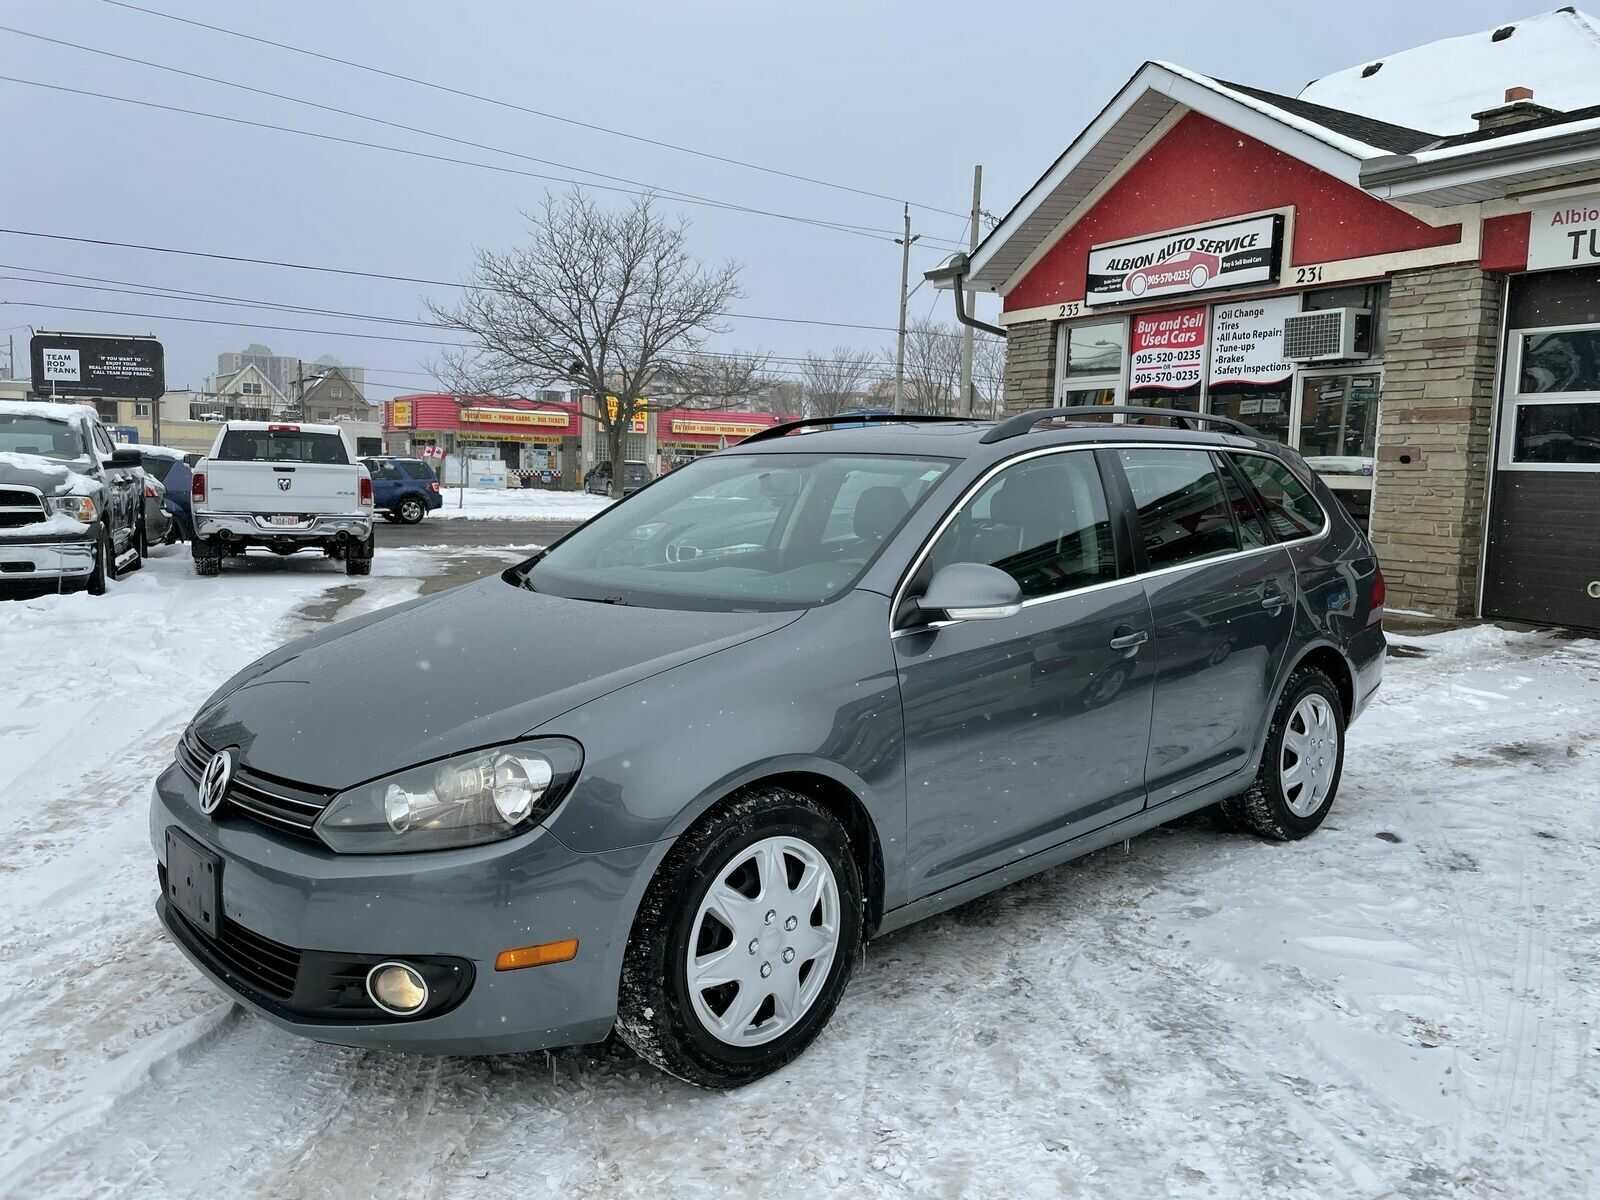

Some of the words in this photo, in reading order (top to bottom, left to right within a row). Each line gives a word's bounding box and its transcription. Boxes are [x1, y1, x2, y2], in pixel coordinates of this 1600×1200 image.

[1106, 254, 1153, 270] ALBION
[1157, 238, 1195, 261] AUTO
[1197, 233, 1259, 254] SERVICE
[1147, 269, 1190, 286] 905-570-0235
[1296, 266, 1322, 284] 231
[1059, 304, 1079, 317] 233
[1221, 310, 1232, 320] Oil
[1234, 308, 1264, 318] Change
[1137, 320, 1157, 335] Buy
[1159, 316, 1182, 330] and
[1183, 313, 1204, 326] Sell
[1221, 322, 1240, 330] Tires
[1141, 332, 1170, 346] Used
[1170, 330, 1196, 343] Cars
[1219, 333, 1232, 342] All
[1232, 332, 1250, 341] Auto
[1219, 343, 1256, 352] Tune-ups
[1136, 350, 1200, 364] 905-520-0235
[1218, 355, 1245, 364] Brakes
[1217, 365, 1242, 376] Safety
[1244, 362, 1292, 374] Inspections
[1135, 370, 1200, 384] 905-570-0235
